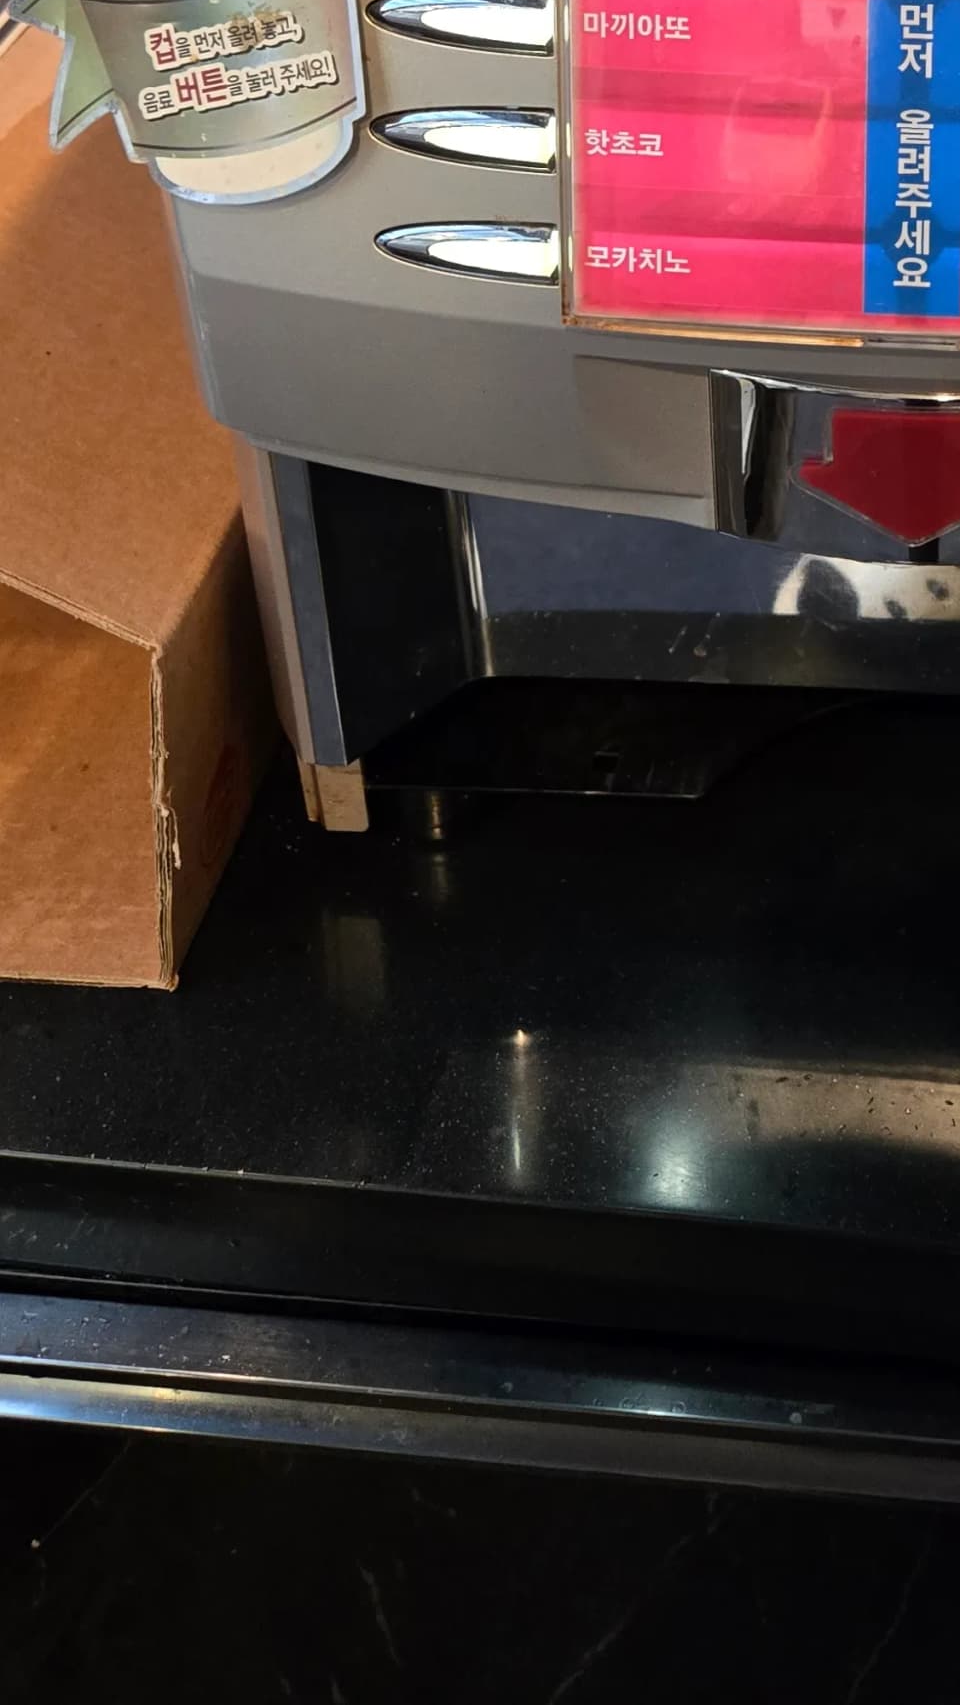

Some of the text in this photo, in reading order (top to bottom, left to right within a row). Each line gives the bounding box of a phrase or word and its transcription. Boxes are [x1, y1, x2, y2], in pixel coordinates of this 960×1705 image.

[149, 17, 298, 65] 컵을 먼저 올려 놓고,
[583, 12, 691, 40] 마끼아또
[898, 4, 934, 79] 먼저
[143, 57, 332, 114] 음료 버튼을 눌러 주세요!
[584, 129, 664, 157] 핫초코
[584, 246, 692, 274] 모카치노
